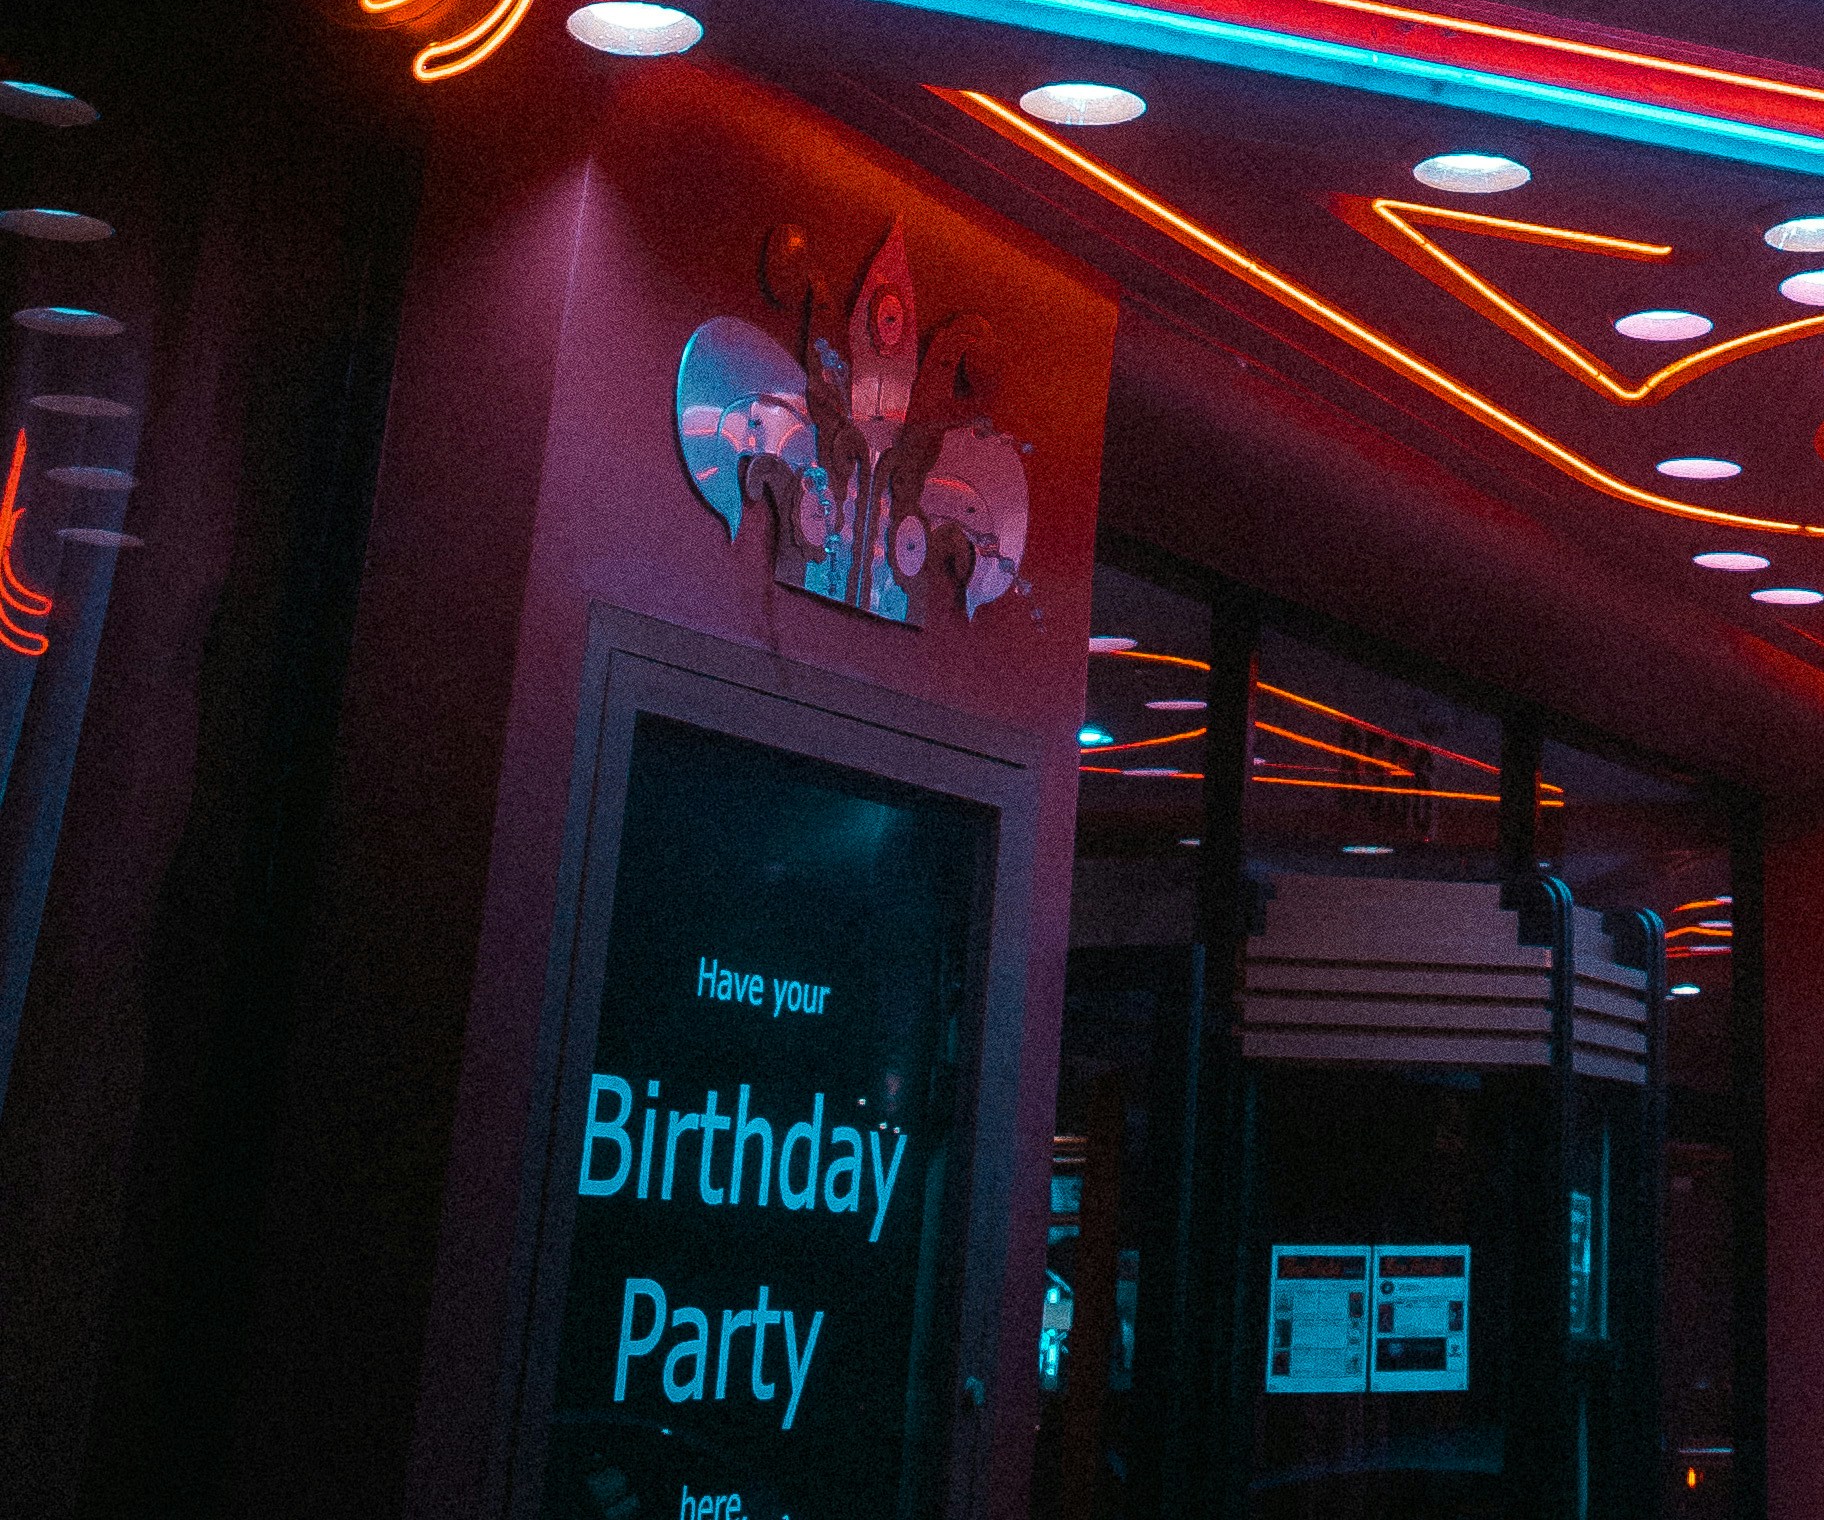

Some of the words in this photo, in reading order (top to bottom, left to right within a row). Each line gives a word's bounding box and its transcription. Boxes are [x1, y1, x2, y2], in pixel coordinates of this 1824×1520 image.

[697, 956, 765, 1007] Have
[772, 979, 832, 1018] your
[578, 1073, 908, 1243] Birthday
[613, 1277, 825, 1431] Party
